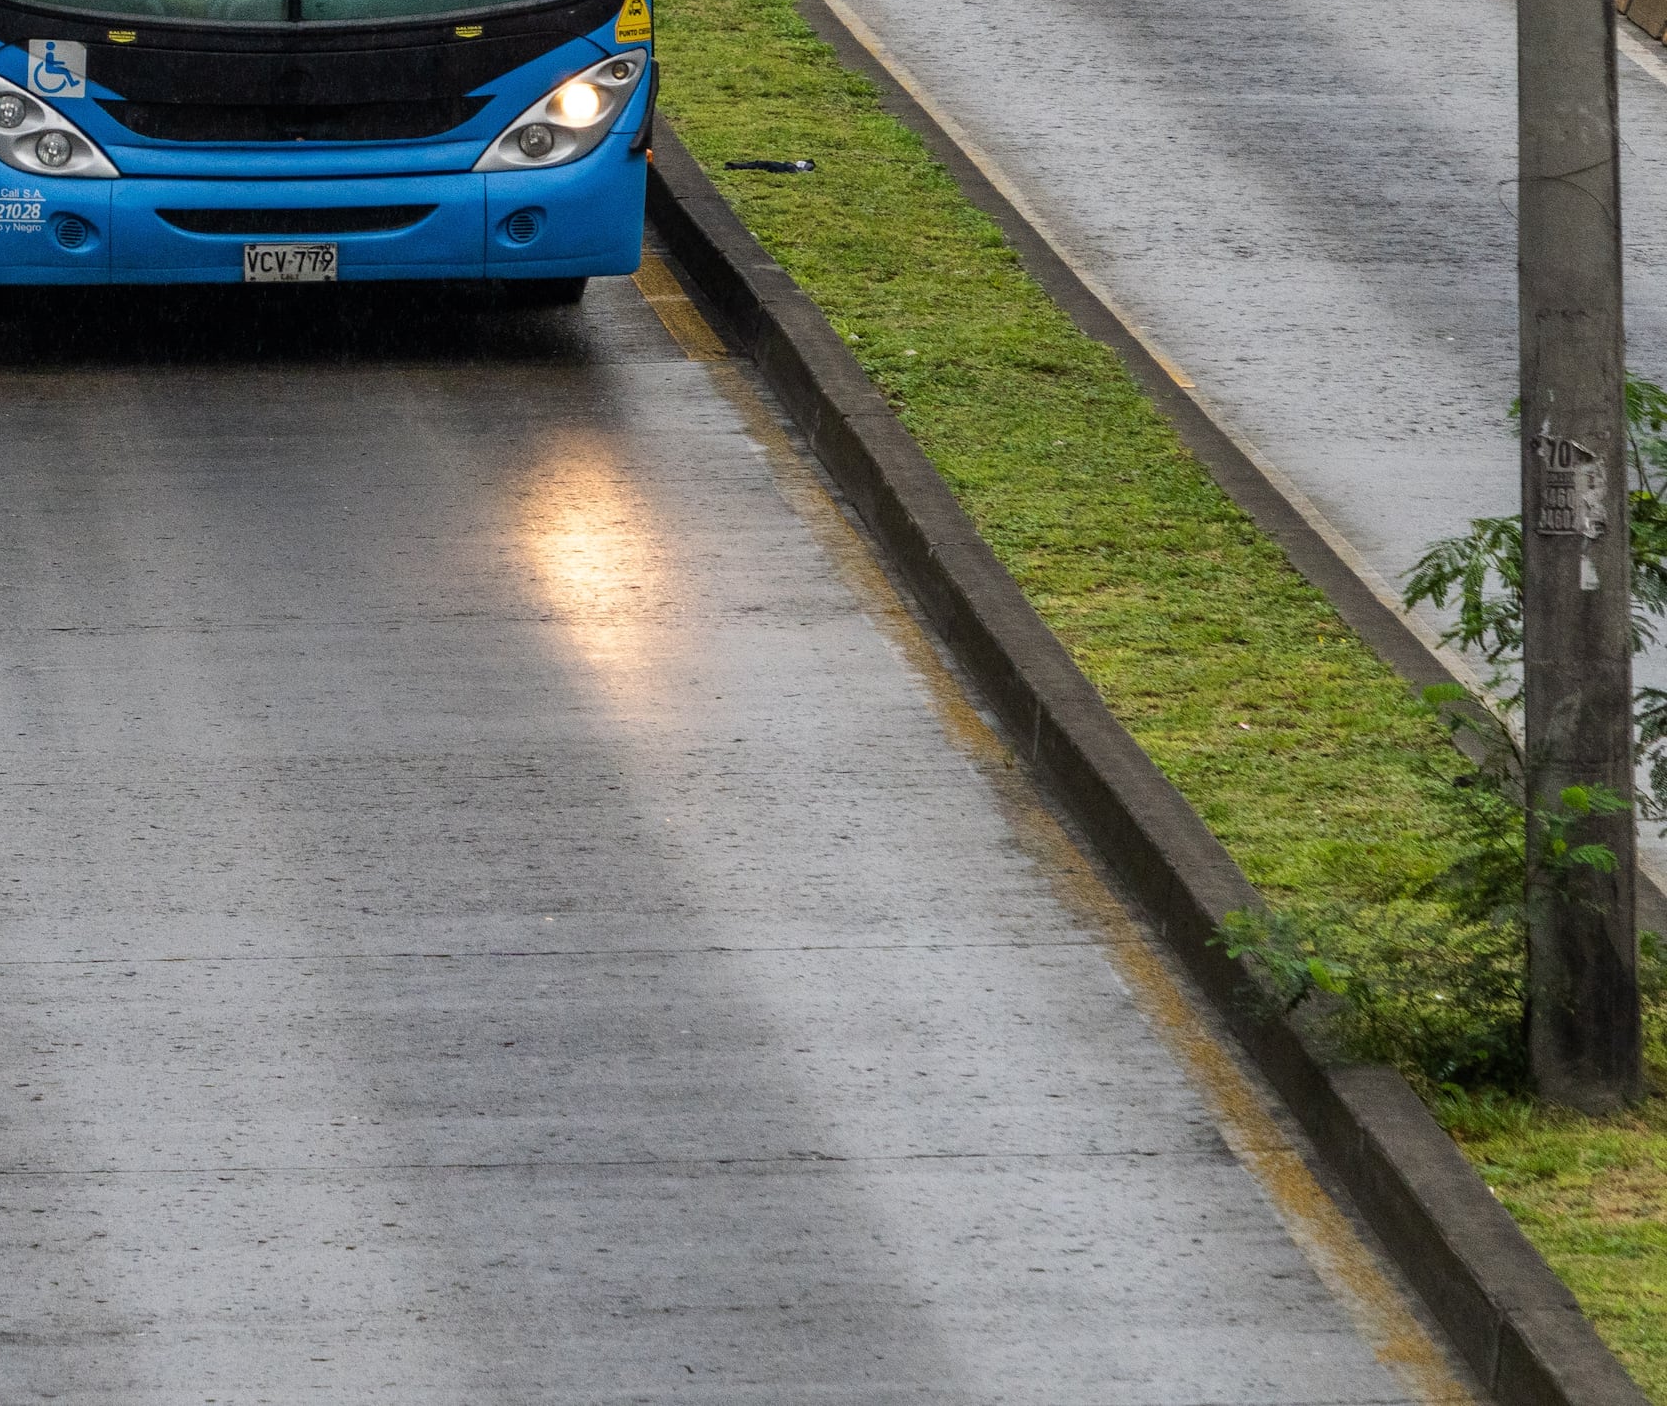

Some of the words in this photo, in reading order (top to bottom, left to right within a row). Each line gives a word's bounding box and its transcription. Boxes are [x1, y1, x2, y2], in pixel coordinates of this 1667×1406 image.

[619, 30, 638, 38] PUNTO
[0, 188, 20, 198] Cali
[5, 224, 11, 232] y
[13, 222, 42, 233] Negro
